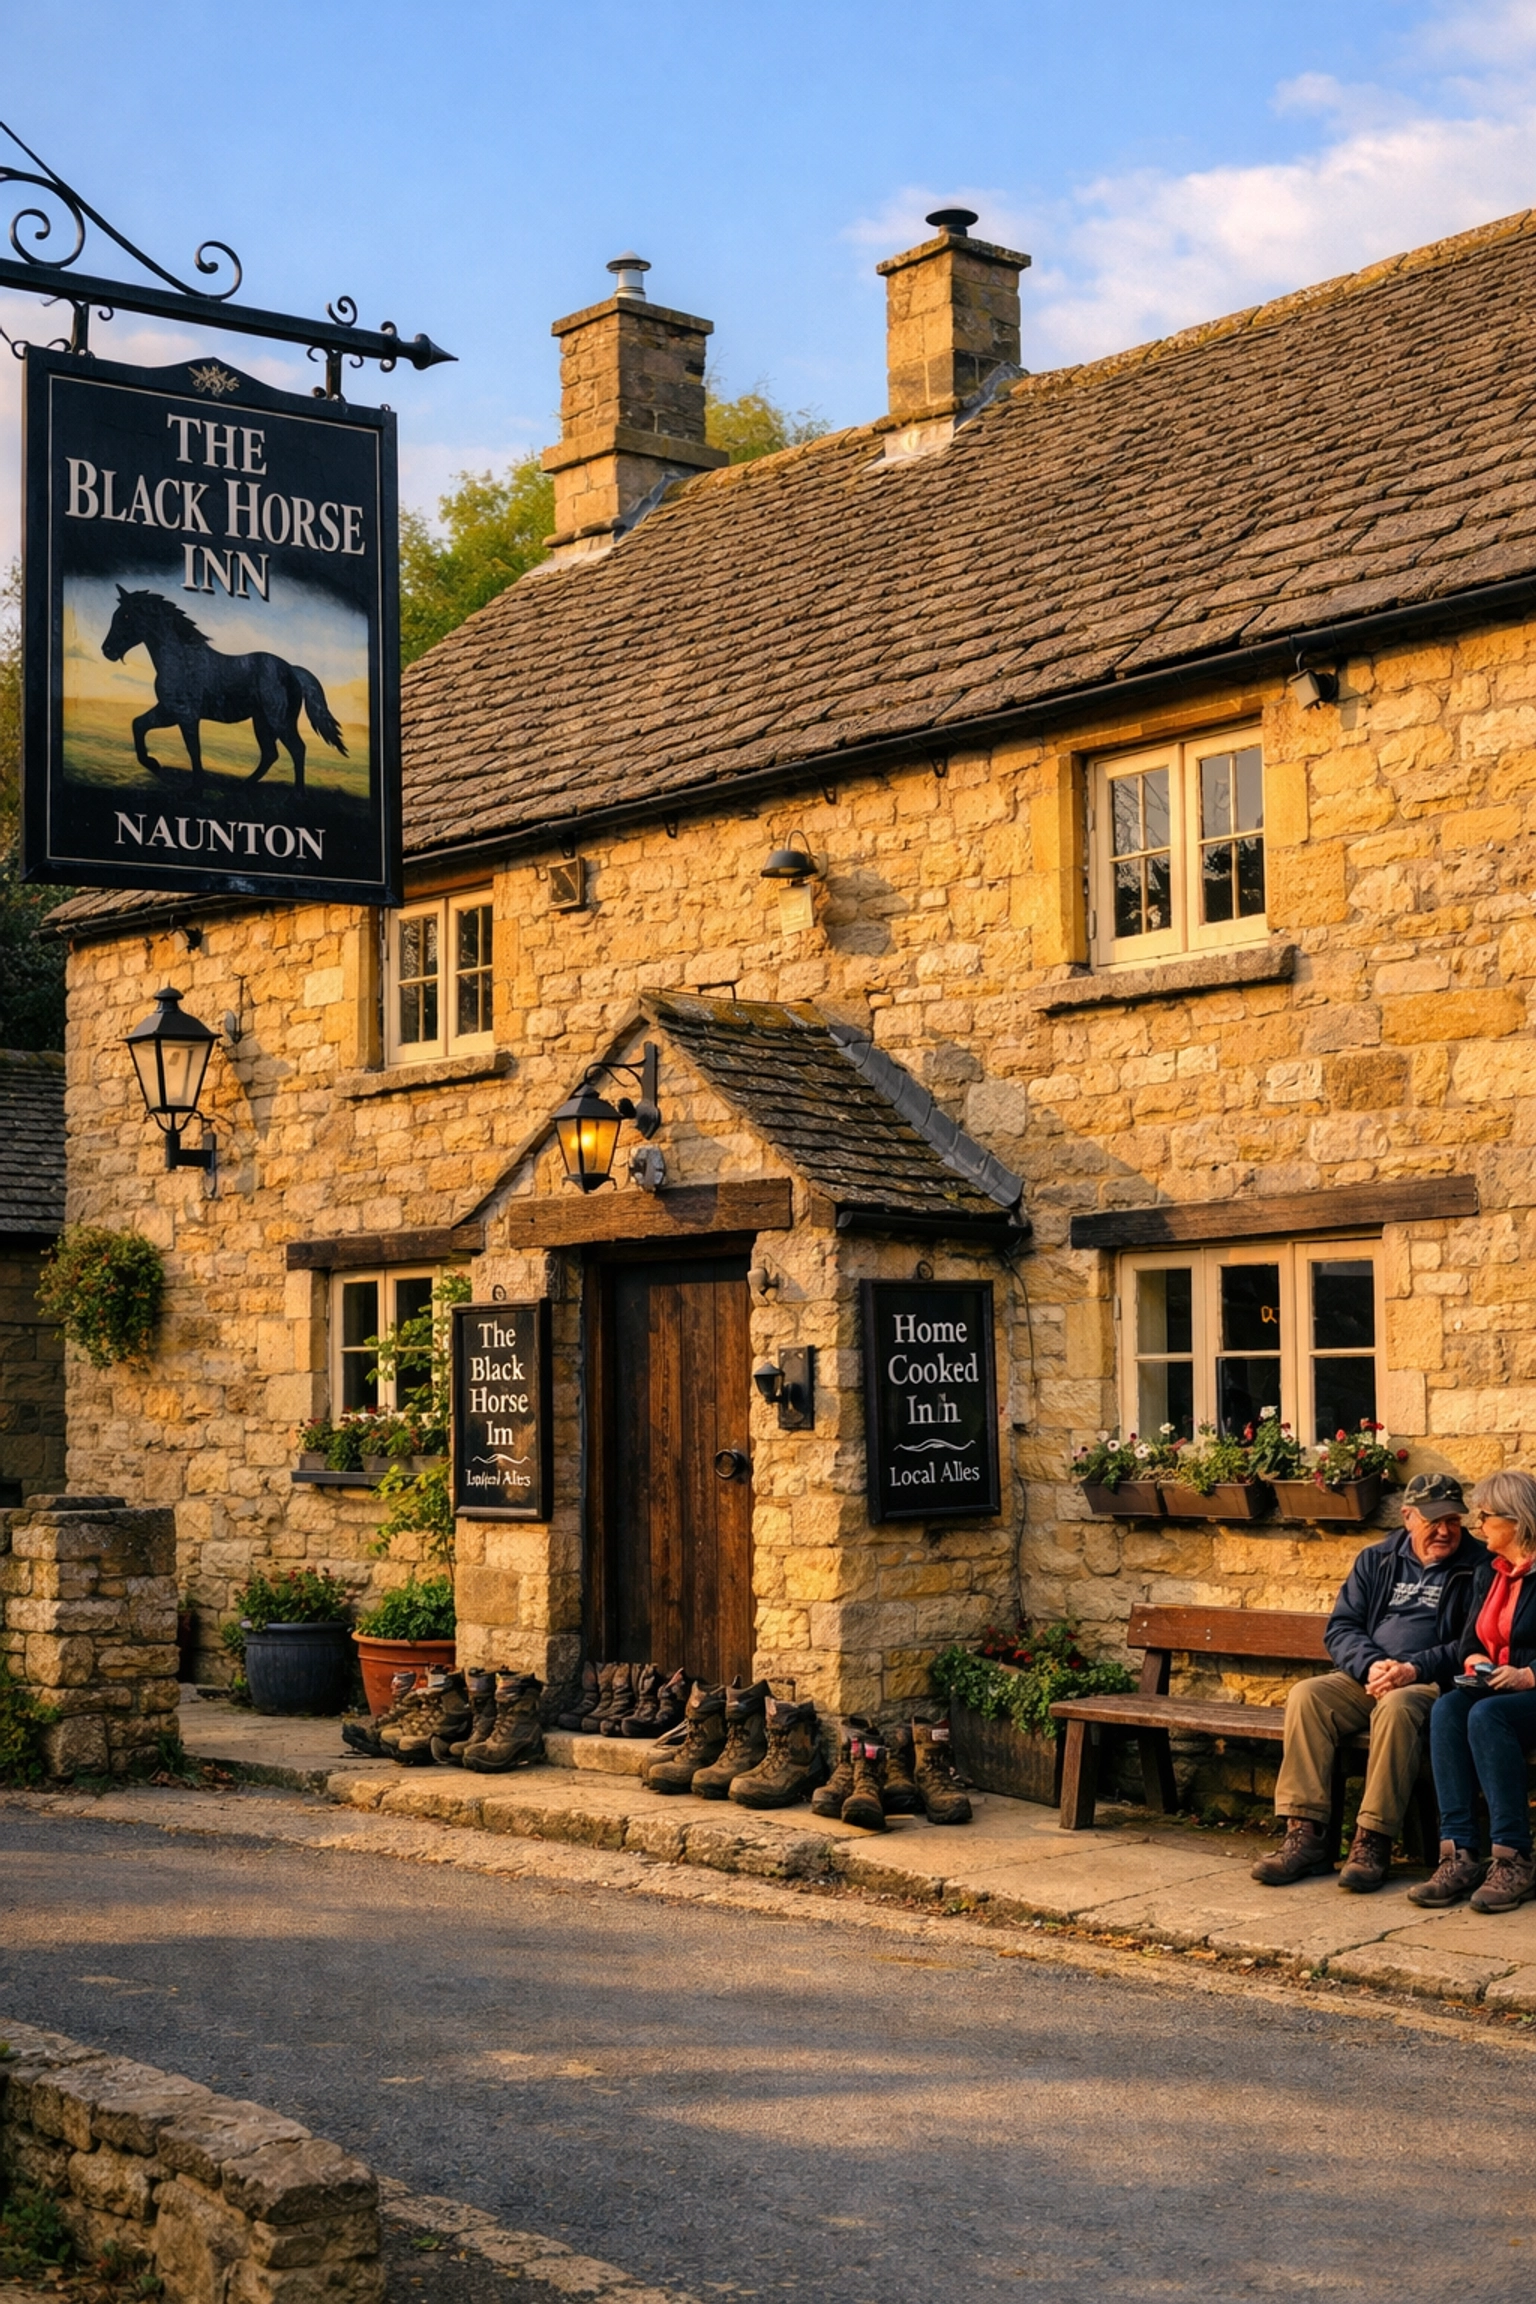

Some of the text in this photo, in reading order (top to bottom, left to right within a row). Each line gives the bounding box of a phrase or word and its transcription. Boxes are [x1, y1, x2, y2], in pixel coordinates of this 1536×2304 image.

[166, 412, 267, 475] THE
[65, 457, 366, 556] BLACK HORSE
[181, 542, 270, 602] INN
[114, 811, 326, 861] NAUNTON
[477, 1320, 516, 1349] The
[892, 1313, 968, 1344] Home
[470, 1354, 526, 1382] Black
[887, 1352, 980, 1386] Cooked
[469, 1386, 530, 1414] Horse
[890, 1461, 936, 1487] Local
